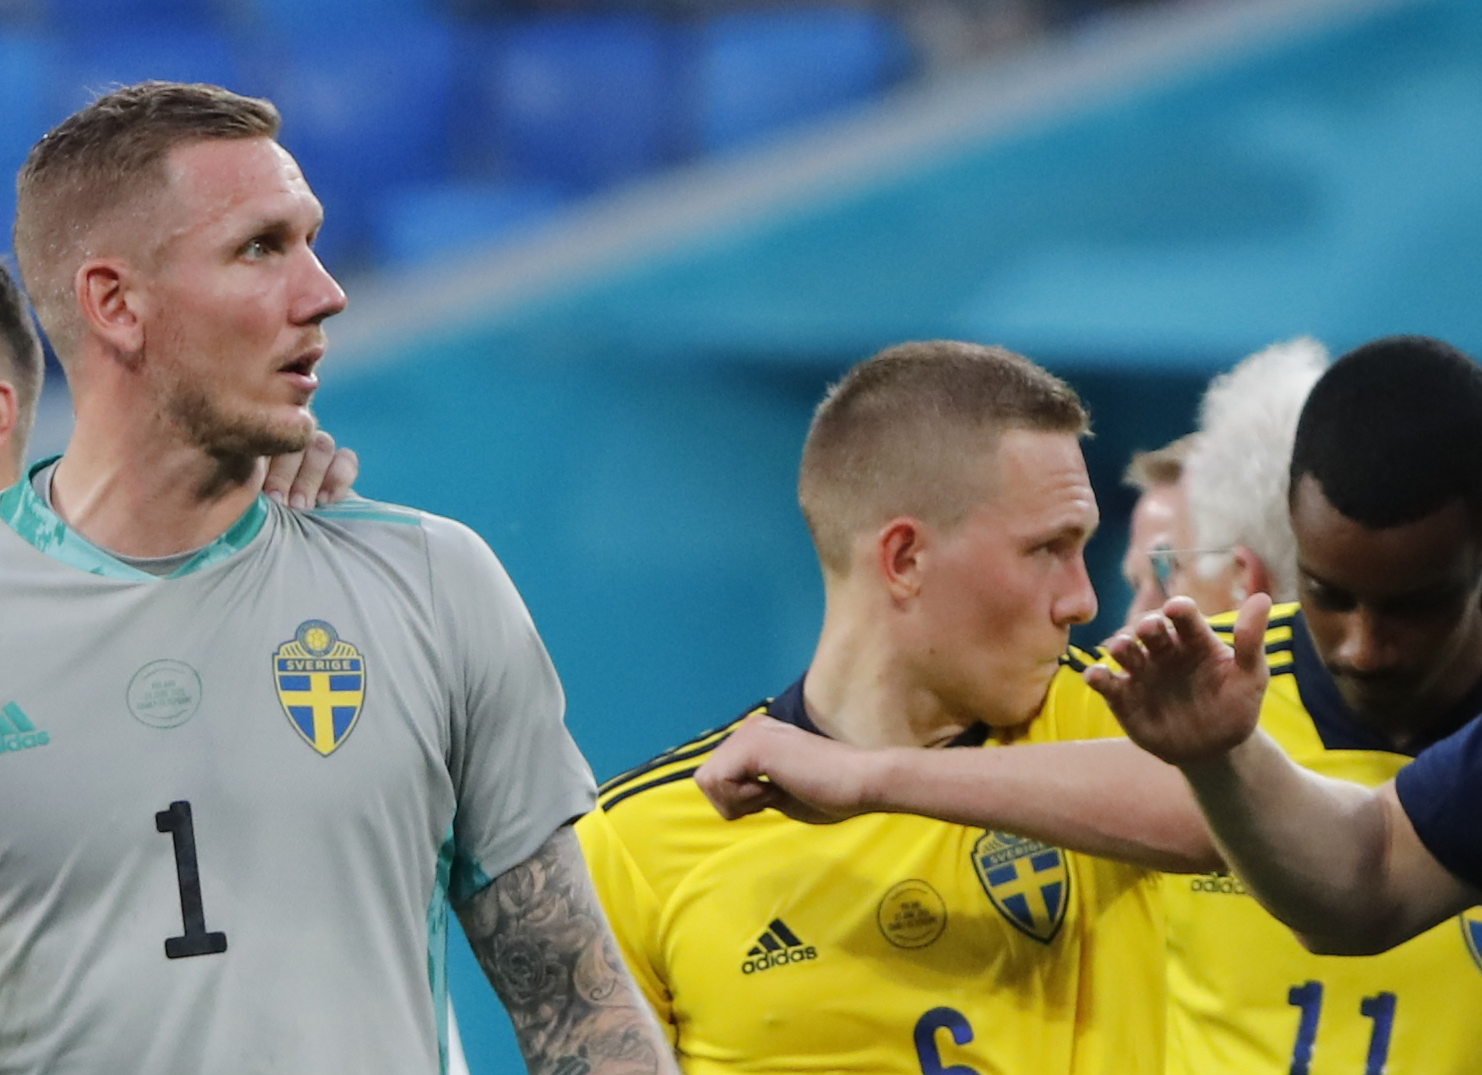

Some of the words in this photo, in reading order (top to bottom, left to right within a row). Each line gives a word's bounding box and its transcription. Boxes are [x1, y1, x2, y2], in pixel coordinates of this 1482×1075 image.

[286, 659, 351, 671] SVERIGE
[155, 800, 228, 959] 1
[741, 946, 817, 975] adidas
